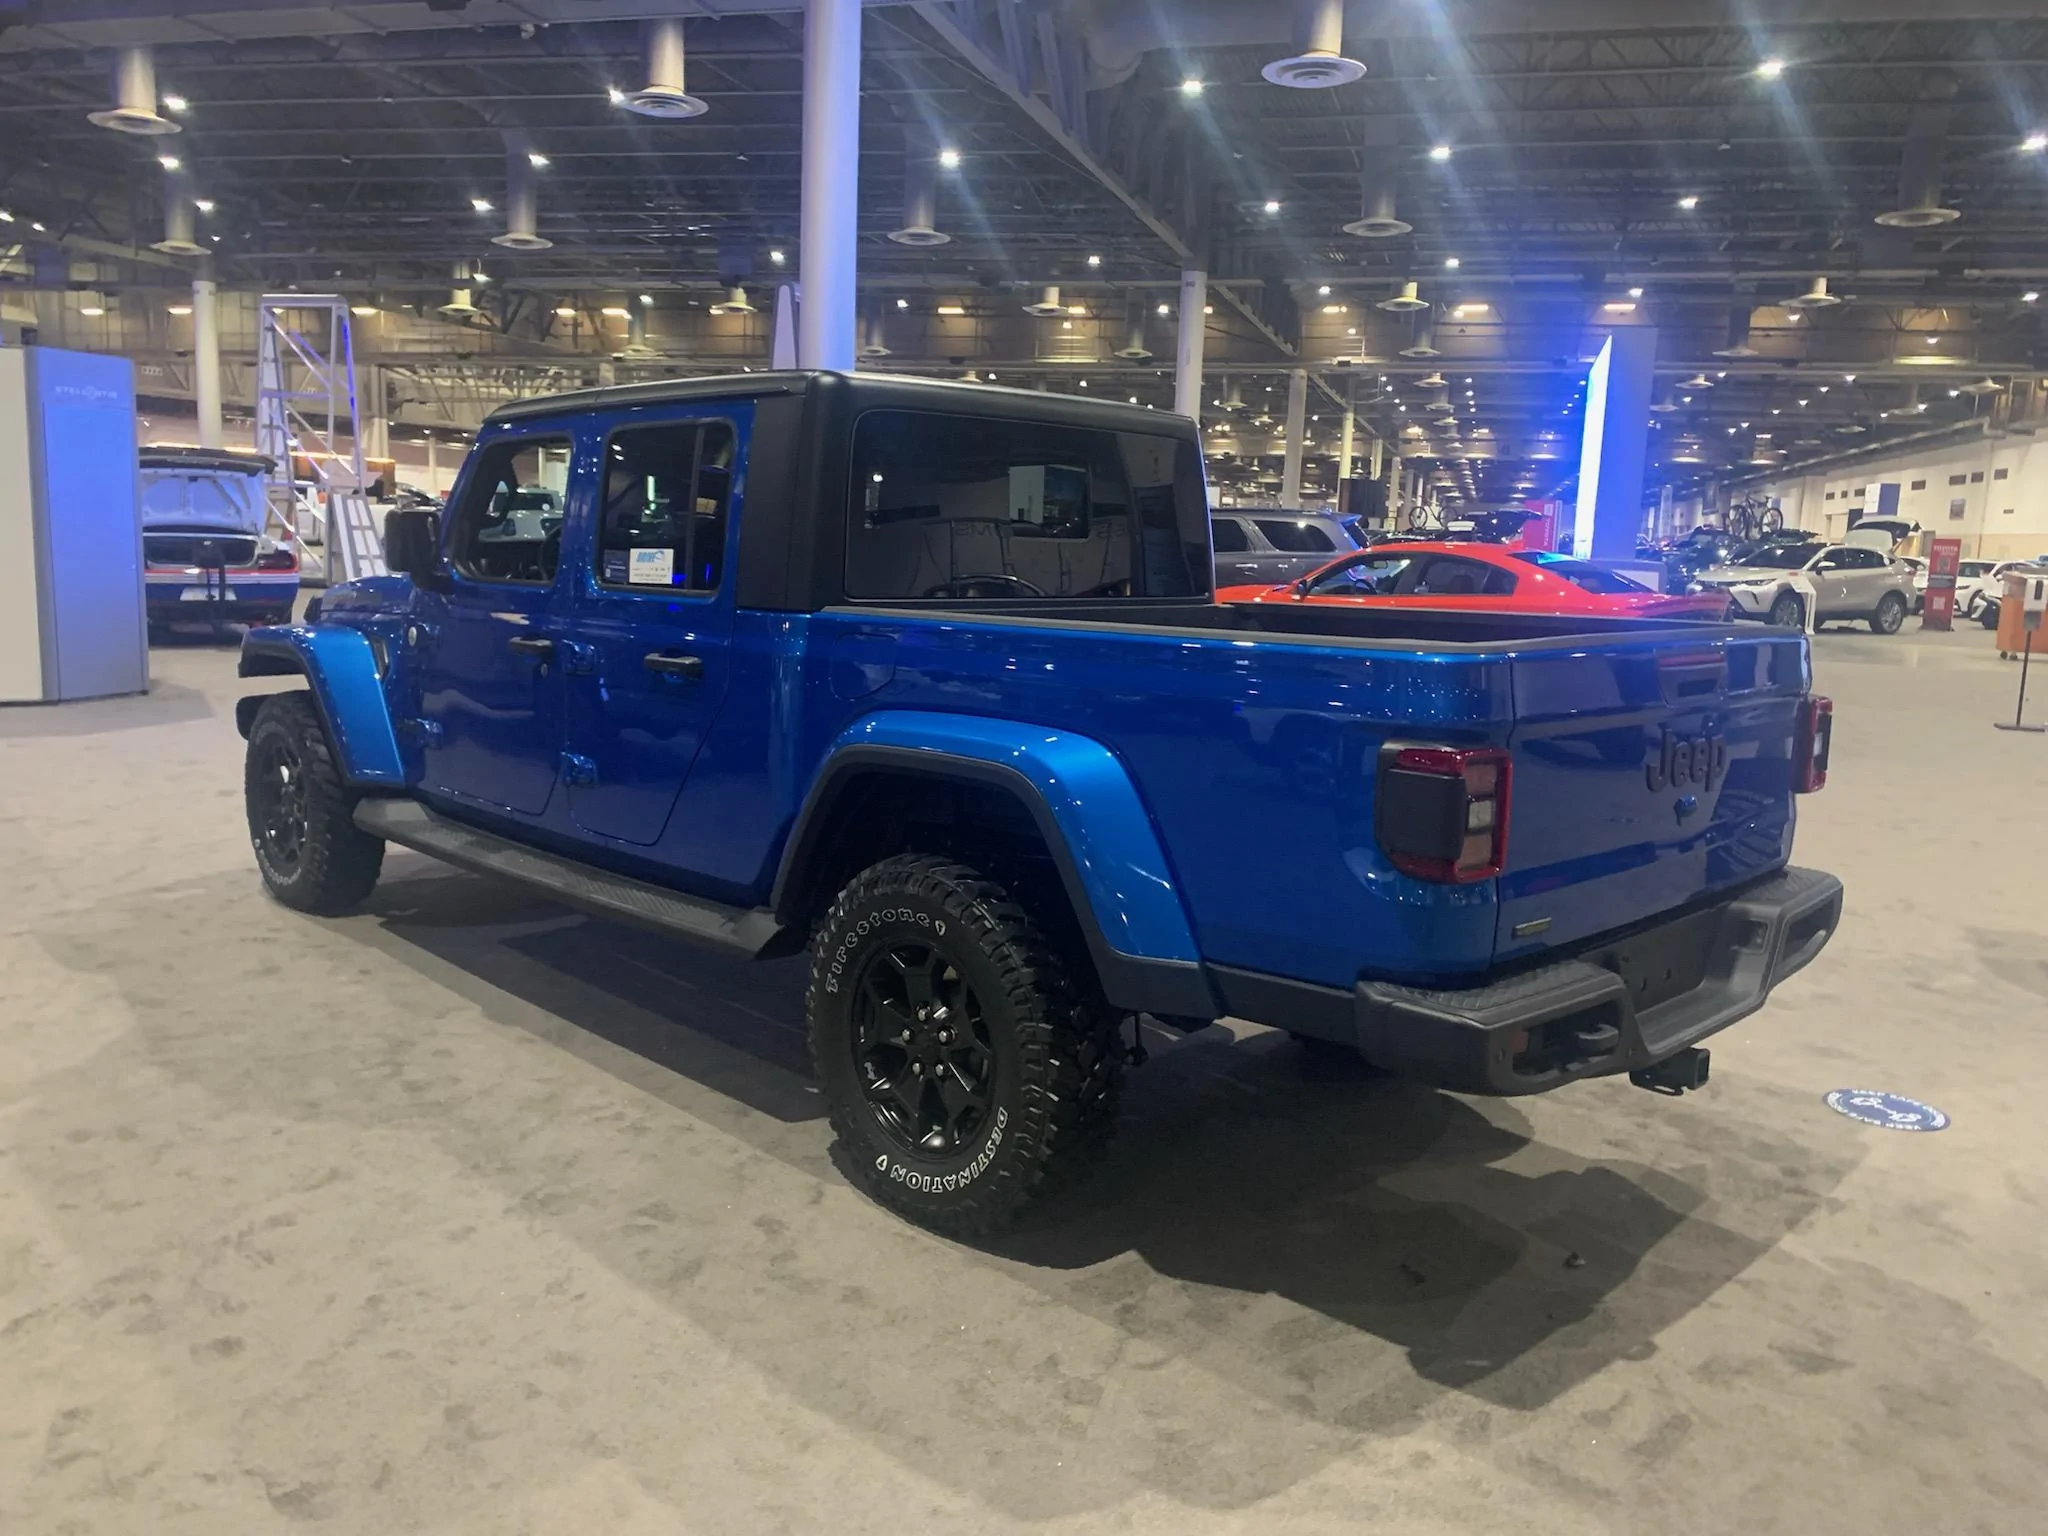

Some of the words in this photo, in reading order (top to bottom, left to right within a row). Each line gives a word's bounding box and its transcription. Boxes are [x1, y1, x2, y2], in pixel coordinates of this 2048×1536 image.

[1645, 725, 1727, 793] Jeep
[826, 908, 930, 993] Firestone
[889, 1107, 1009, 1192] DESTINATION
